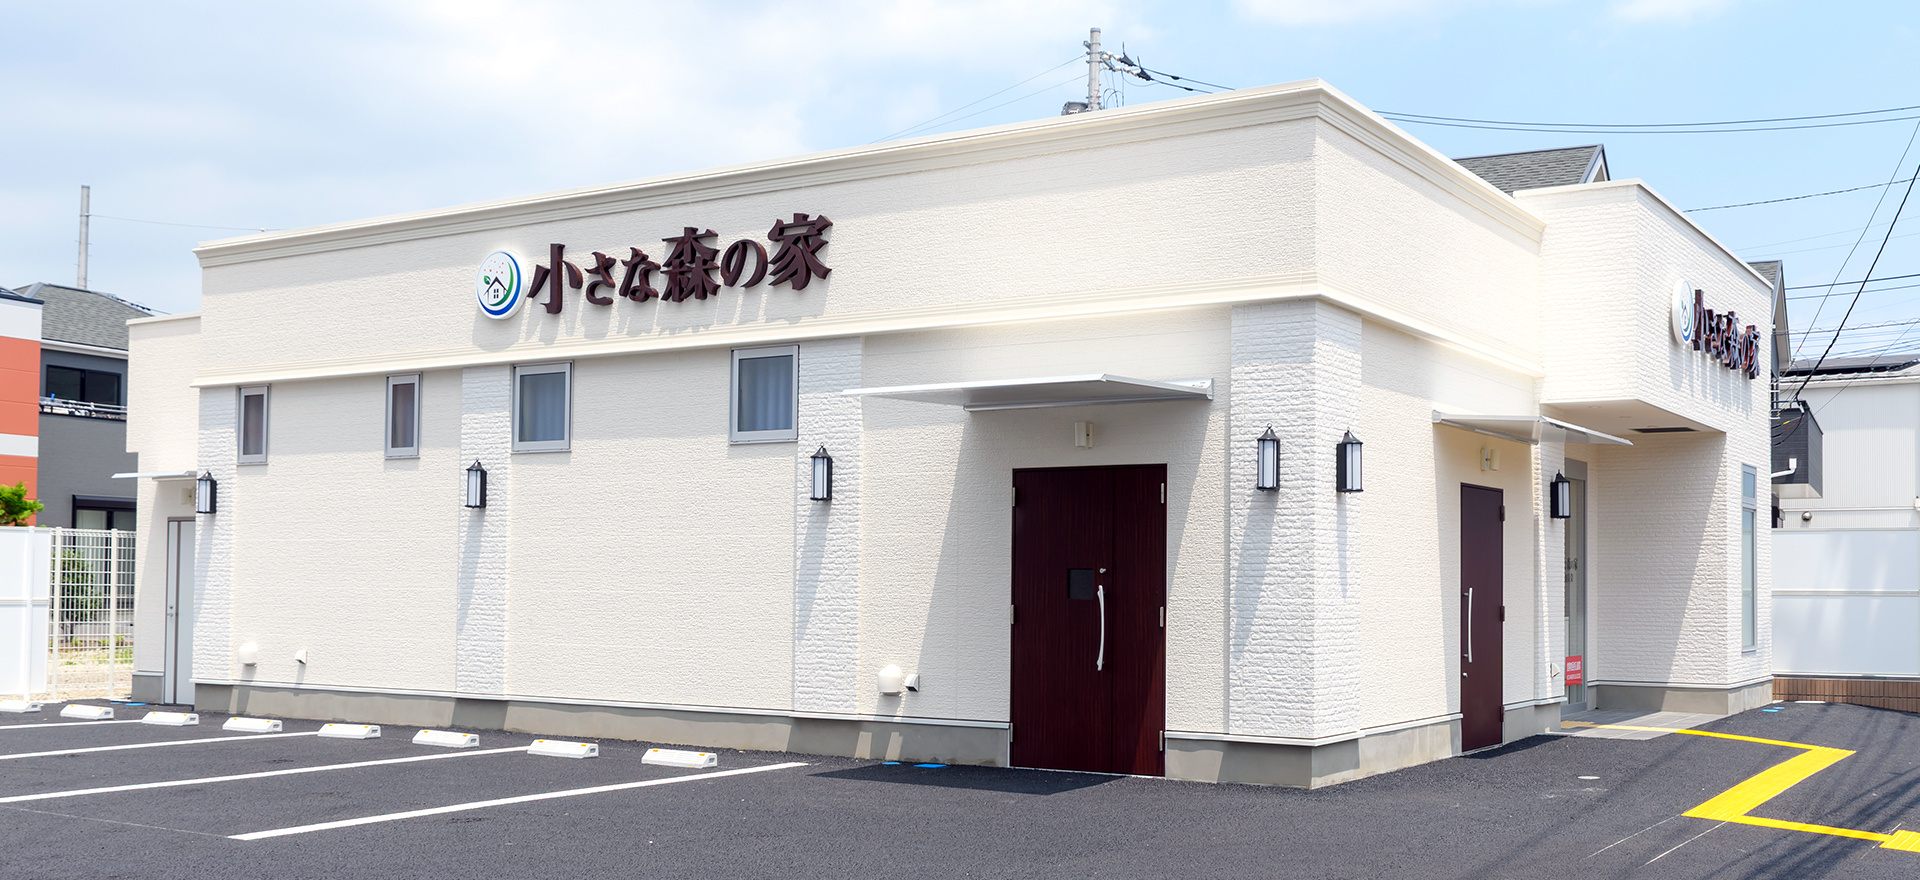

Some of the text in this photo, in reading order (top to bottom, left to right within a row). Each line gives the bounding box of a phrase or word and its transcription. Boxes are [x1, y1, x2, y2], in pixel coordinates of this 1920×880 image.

[527, 213, 833, 314] 小さな森の家
